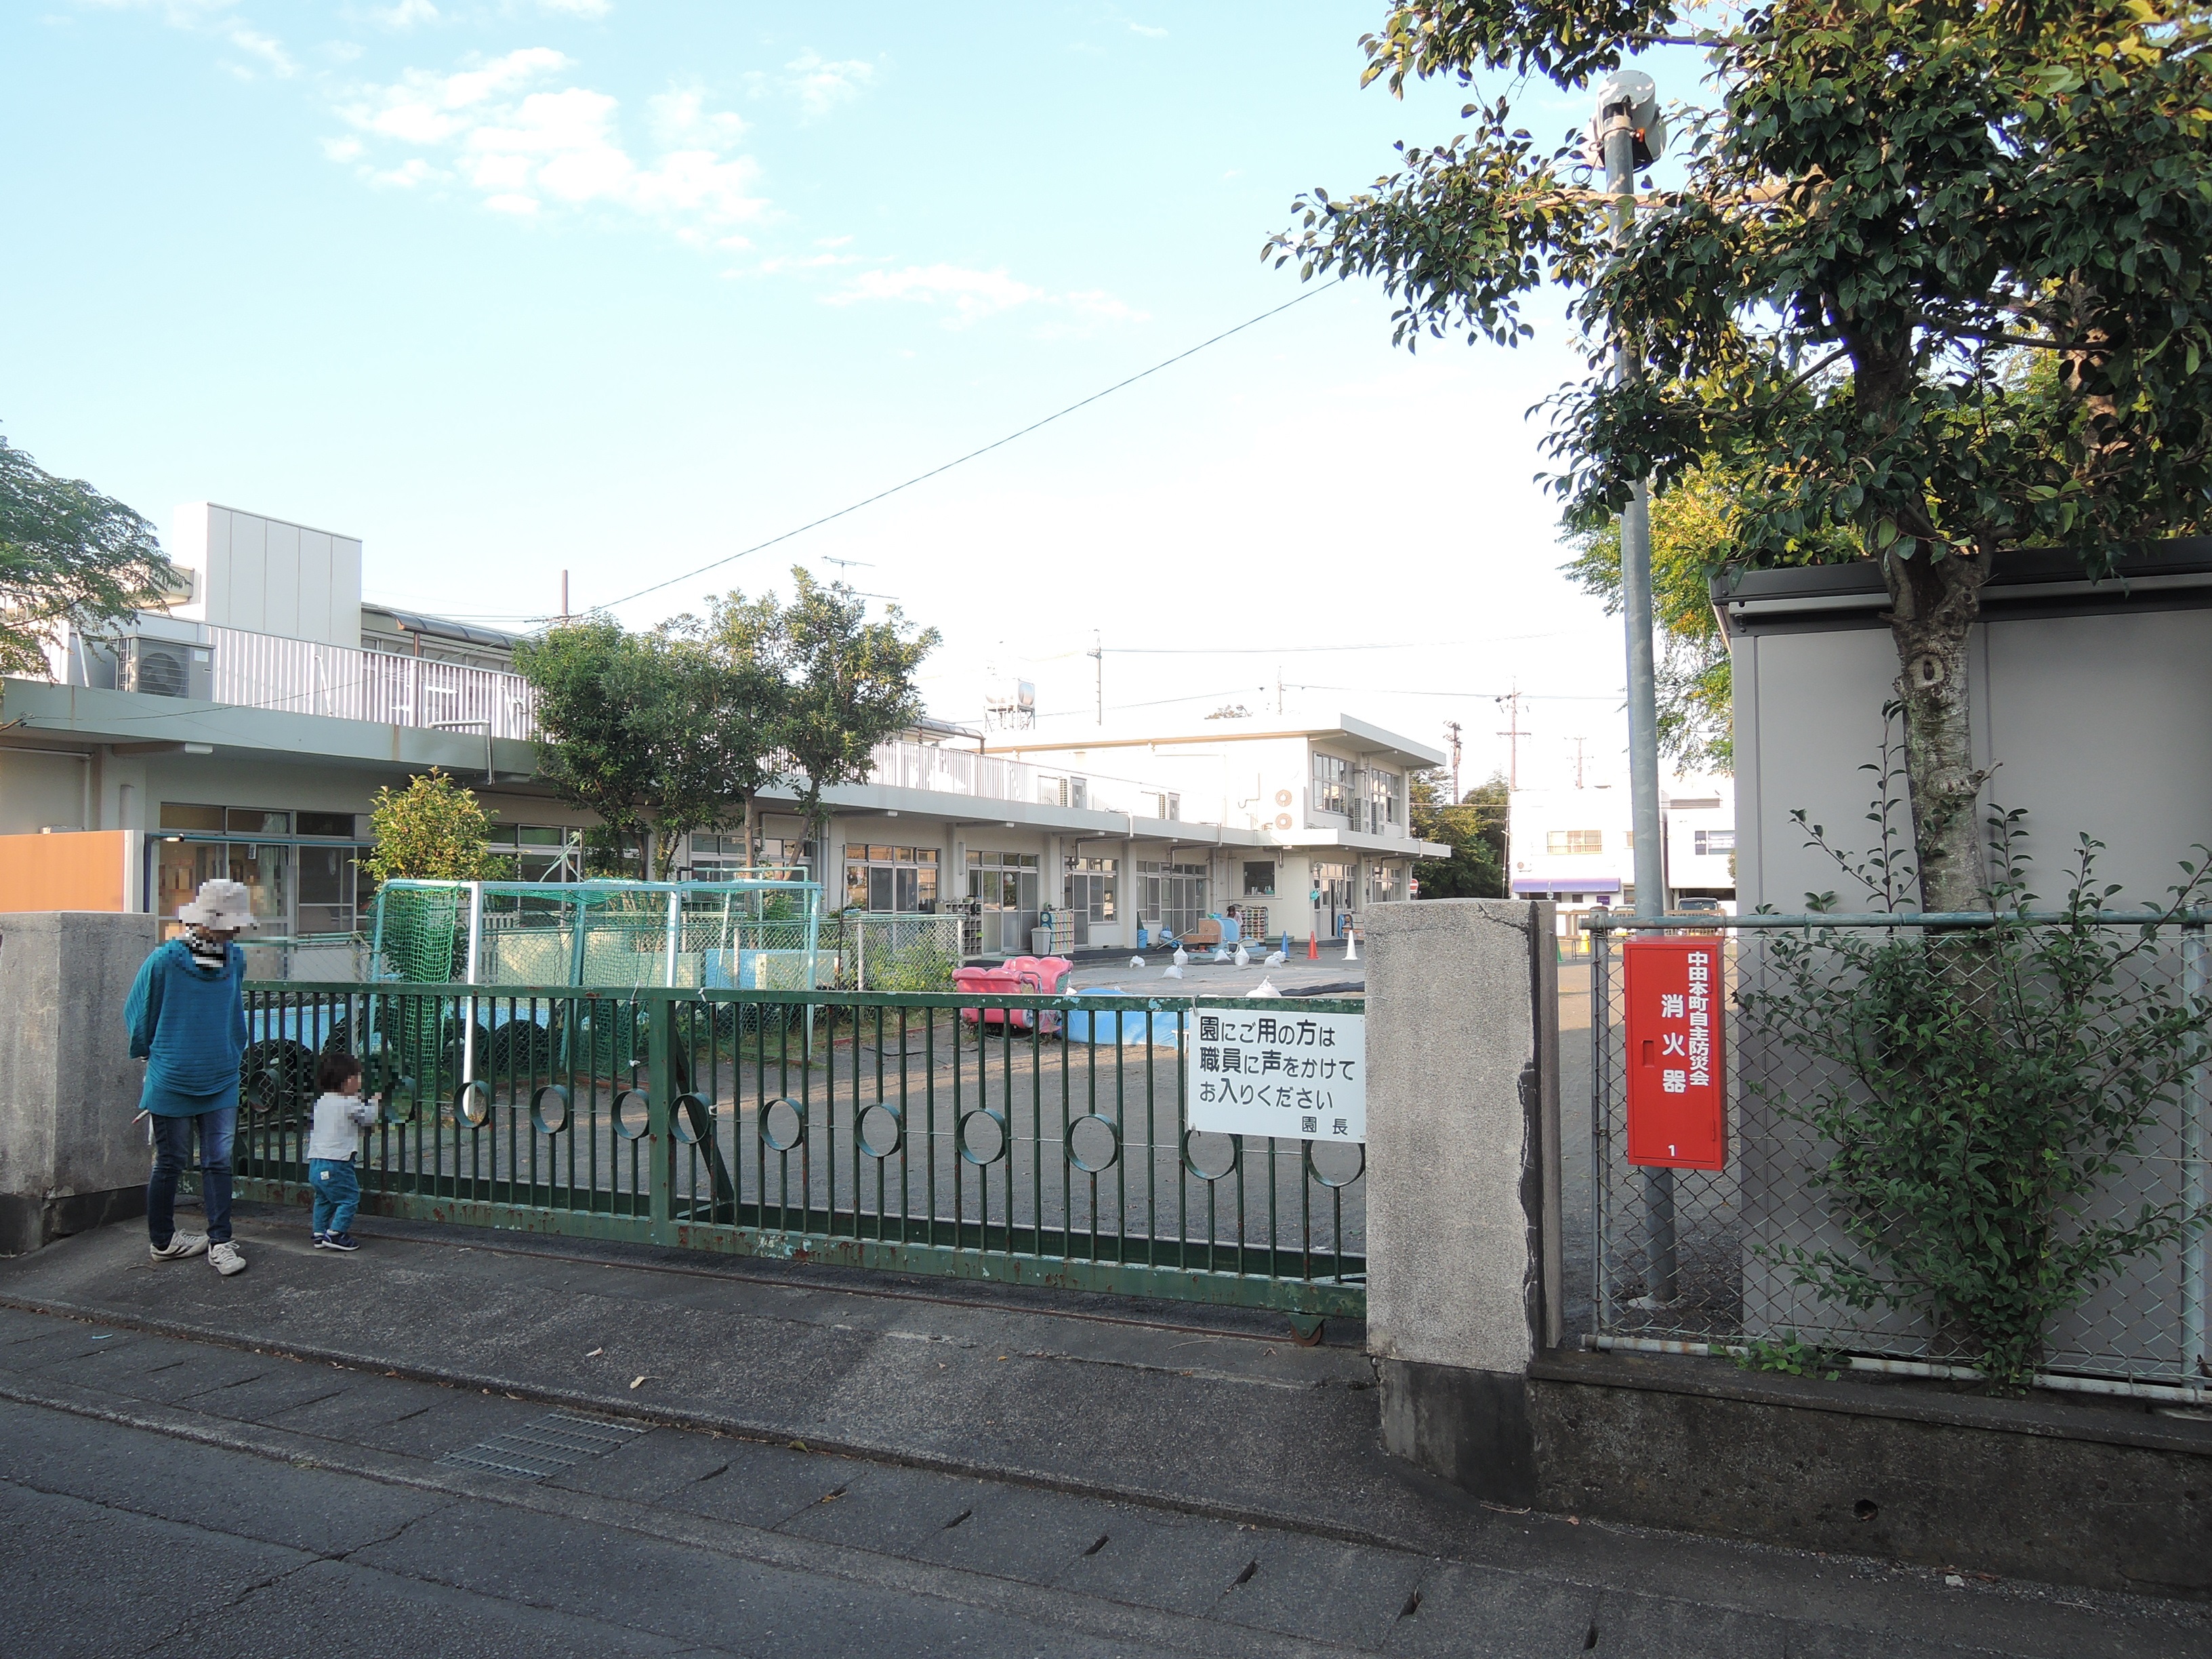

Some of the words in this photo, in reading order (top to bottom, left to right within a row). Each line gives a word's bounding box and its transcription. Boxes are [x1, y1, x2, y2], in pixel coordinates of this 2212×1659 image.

[1200, 1016, 1336, 1047] 園にご用の方は
[1688, 951, 1709, 1086] 中田本町自主防災会
[1661, 994, 1686, 1093] 消火器
[1200, 1046, 1355, 1080] 職員に声をかけて
[1200, 1078, 1333, 1110] お入りください
[1668, 1144, 1676, 1157] 1
